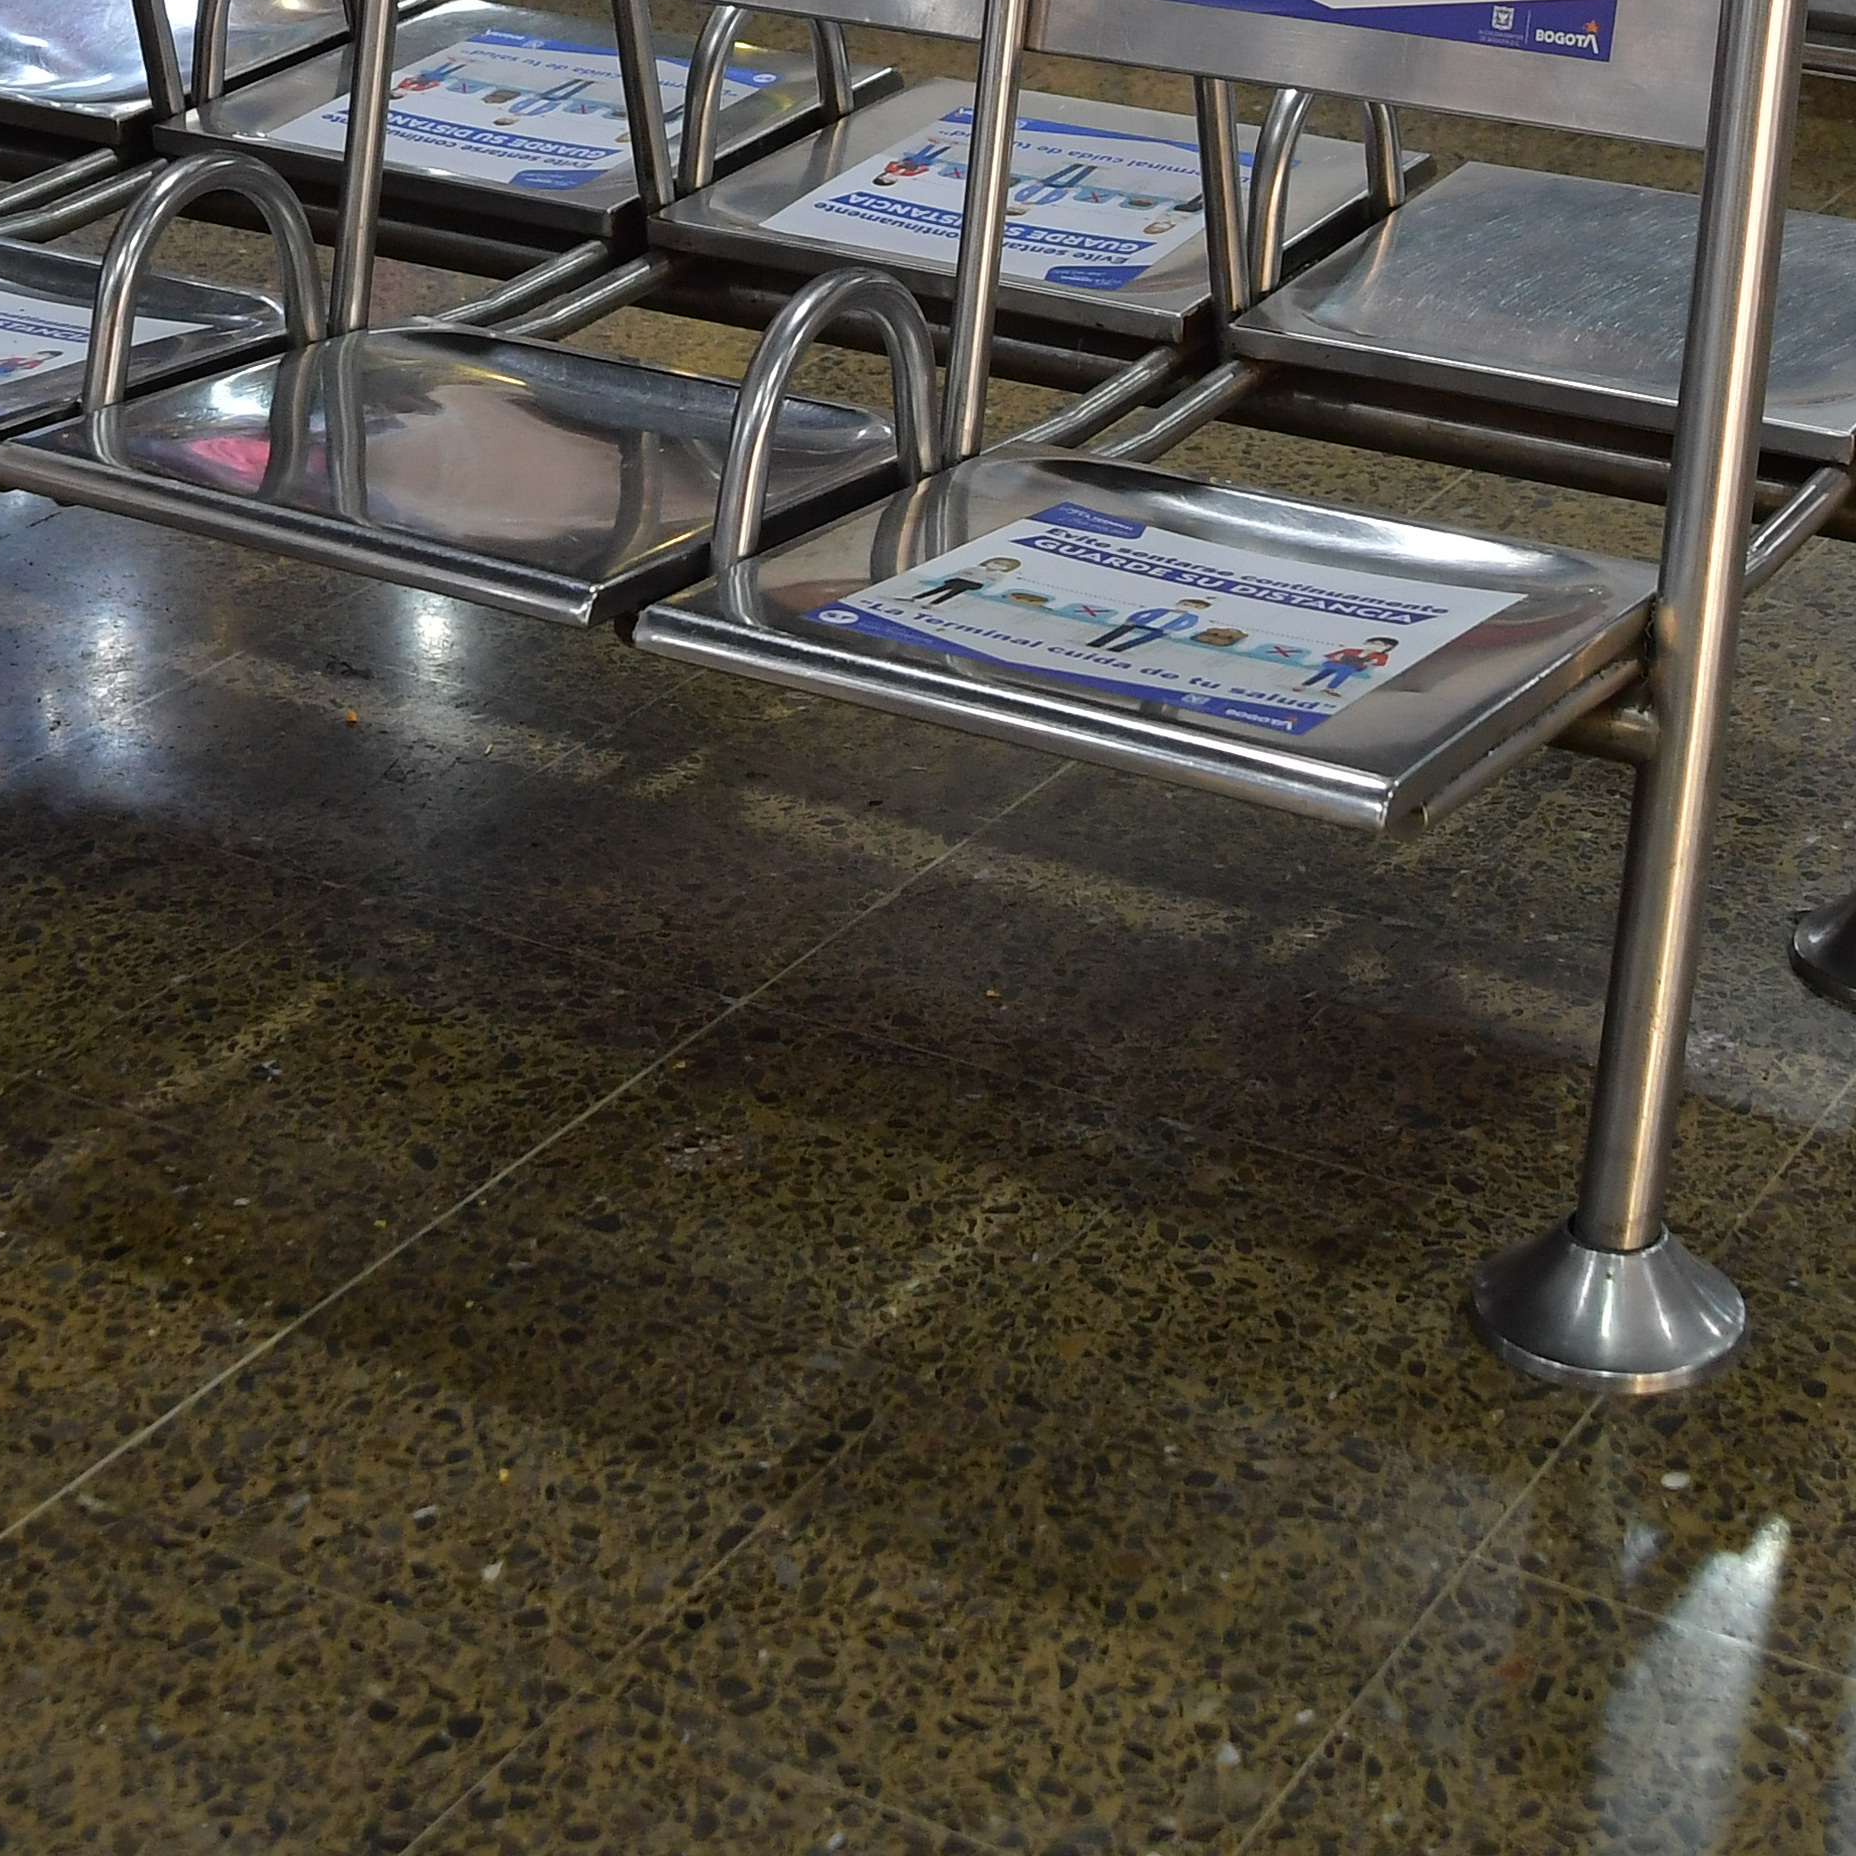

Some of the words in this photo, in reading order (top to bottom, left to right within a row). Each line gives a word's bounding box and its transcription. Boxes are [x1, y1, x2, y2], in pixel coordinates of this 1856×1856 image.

[474, 132, 507, 146] SU
[509, 135, 606, 160] GUARDE
[1036, 143, 1064, 157] de
[1068, 149, 1125, 165] cuida
[813, 201, 960, 241] ontinuamente
[1032, 227, 1140, 254] GUARDE
[1072, 250, 1130, 265] Evite
[1033, 537, 1167, 577] GUARDE
[1175, 572, 1223, 588] SU
[1229, 583, 1413, 624] DISTANCIA
[1046, 528, 1112, 549] Evite
[1116, 546, 1235, 578] sentarse
[1240, 573, 1449, 615] continuamente
[913, 605, 1044, 649] Terminal
[1046, 645, 1131, 669] cuida
[1140, 664, 1180, 680] de
[1187, 674, 1221, 690] tu
